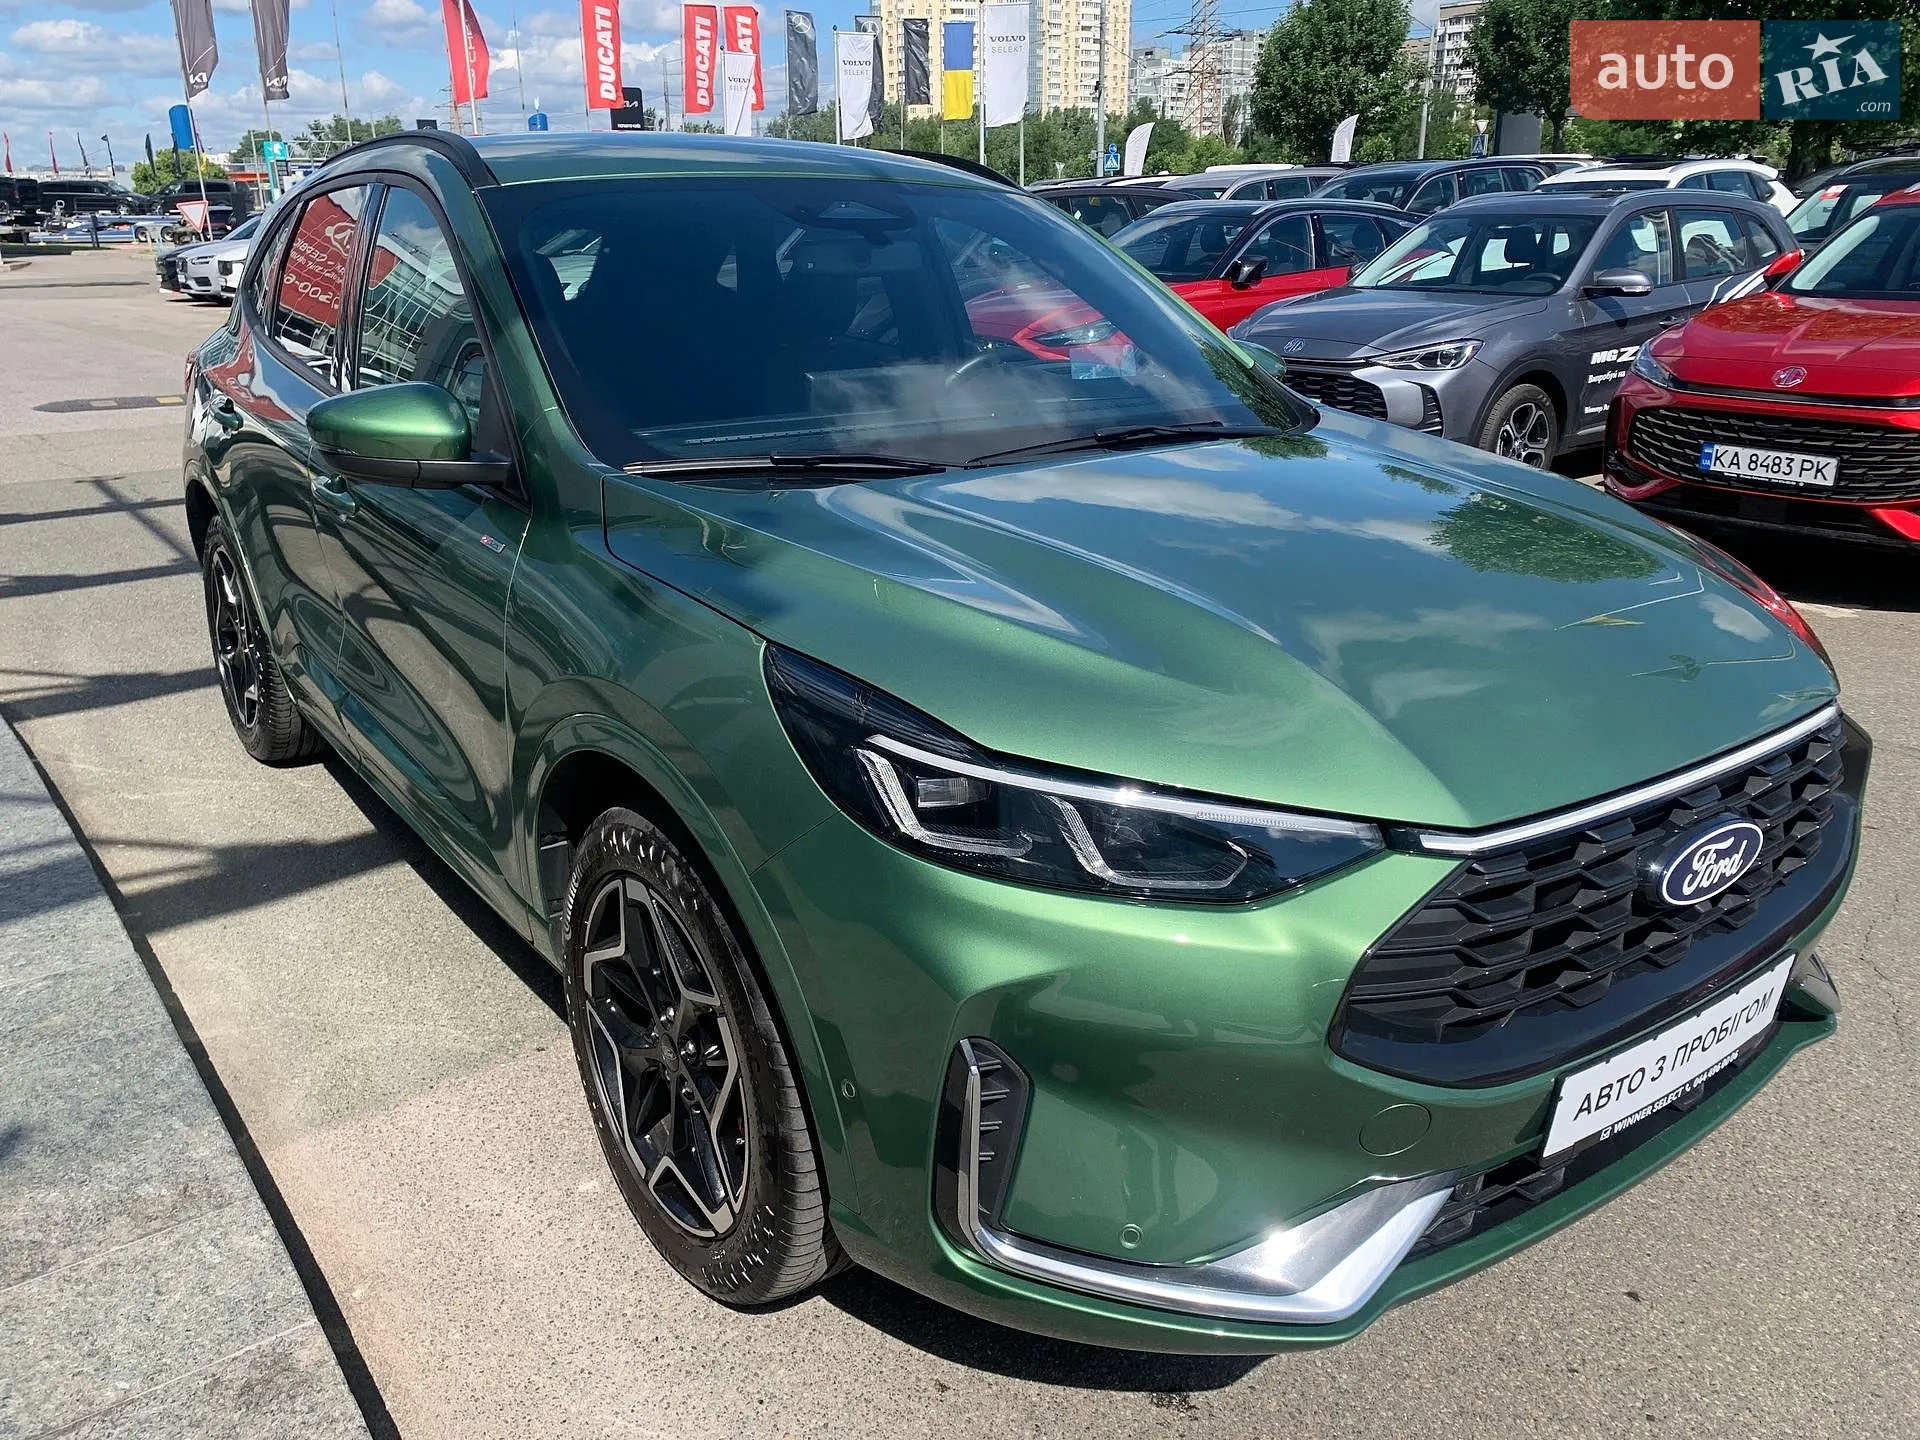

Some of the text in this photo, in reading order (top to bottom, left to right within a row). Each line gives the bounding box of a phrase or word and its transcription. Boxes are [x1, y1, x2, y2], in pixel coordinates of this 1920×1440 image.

[594, 5, 617, 101] DUCATI
[695, 15, 712, 107] DUCATI
[992, 46, 1024, 54] SELEKT
[1713, 449, 1741, 470] KA
[1748, 453, 1795, 476] 8483
[1799, 459, 1831, 481] PK
[1682, 836, 1748, 896] Ford
[1573, 1067, 1646, 1121] АВТО
[1671, 987, 1775, 1072] ПРОБІГОМ
[1612, 1106, 1653, 1134] WINNER
[1652, 1087, 1684, 1113] SELECT
